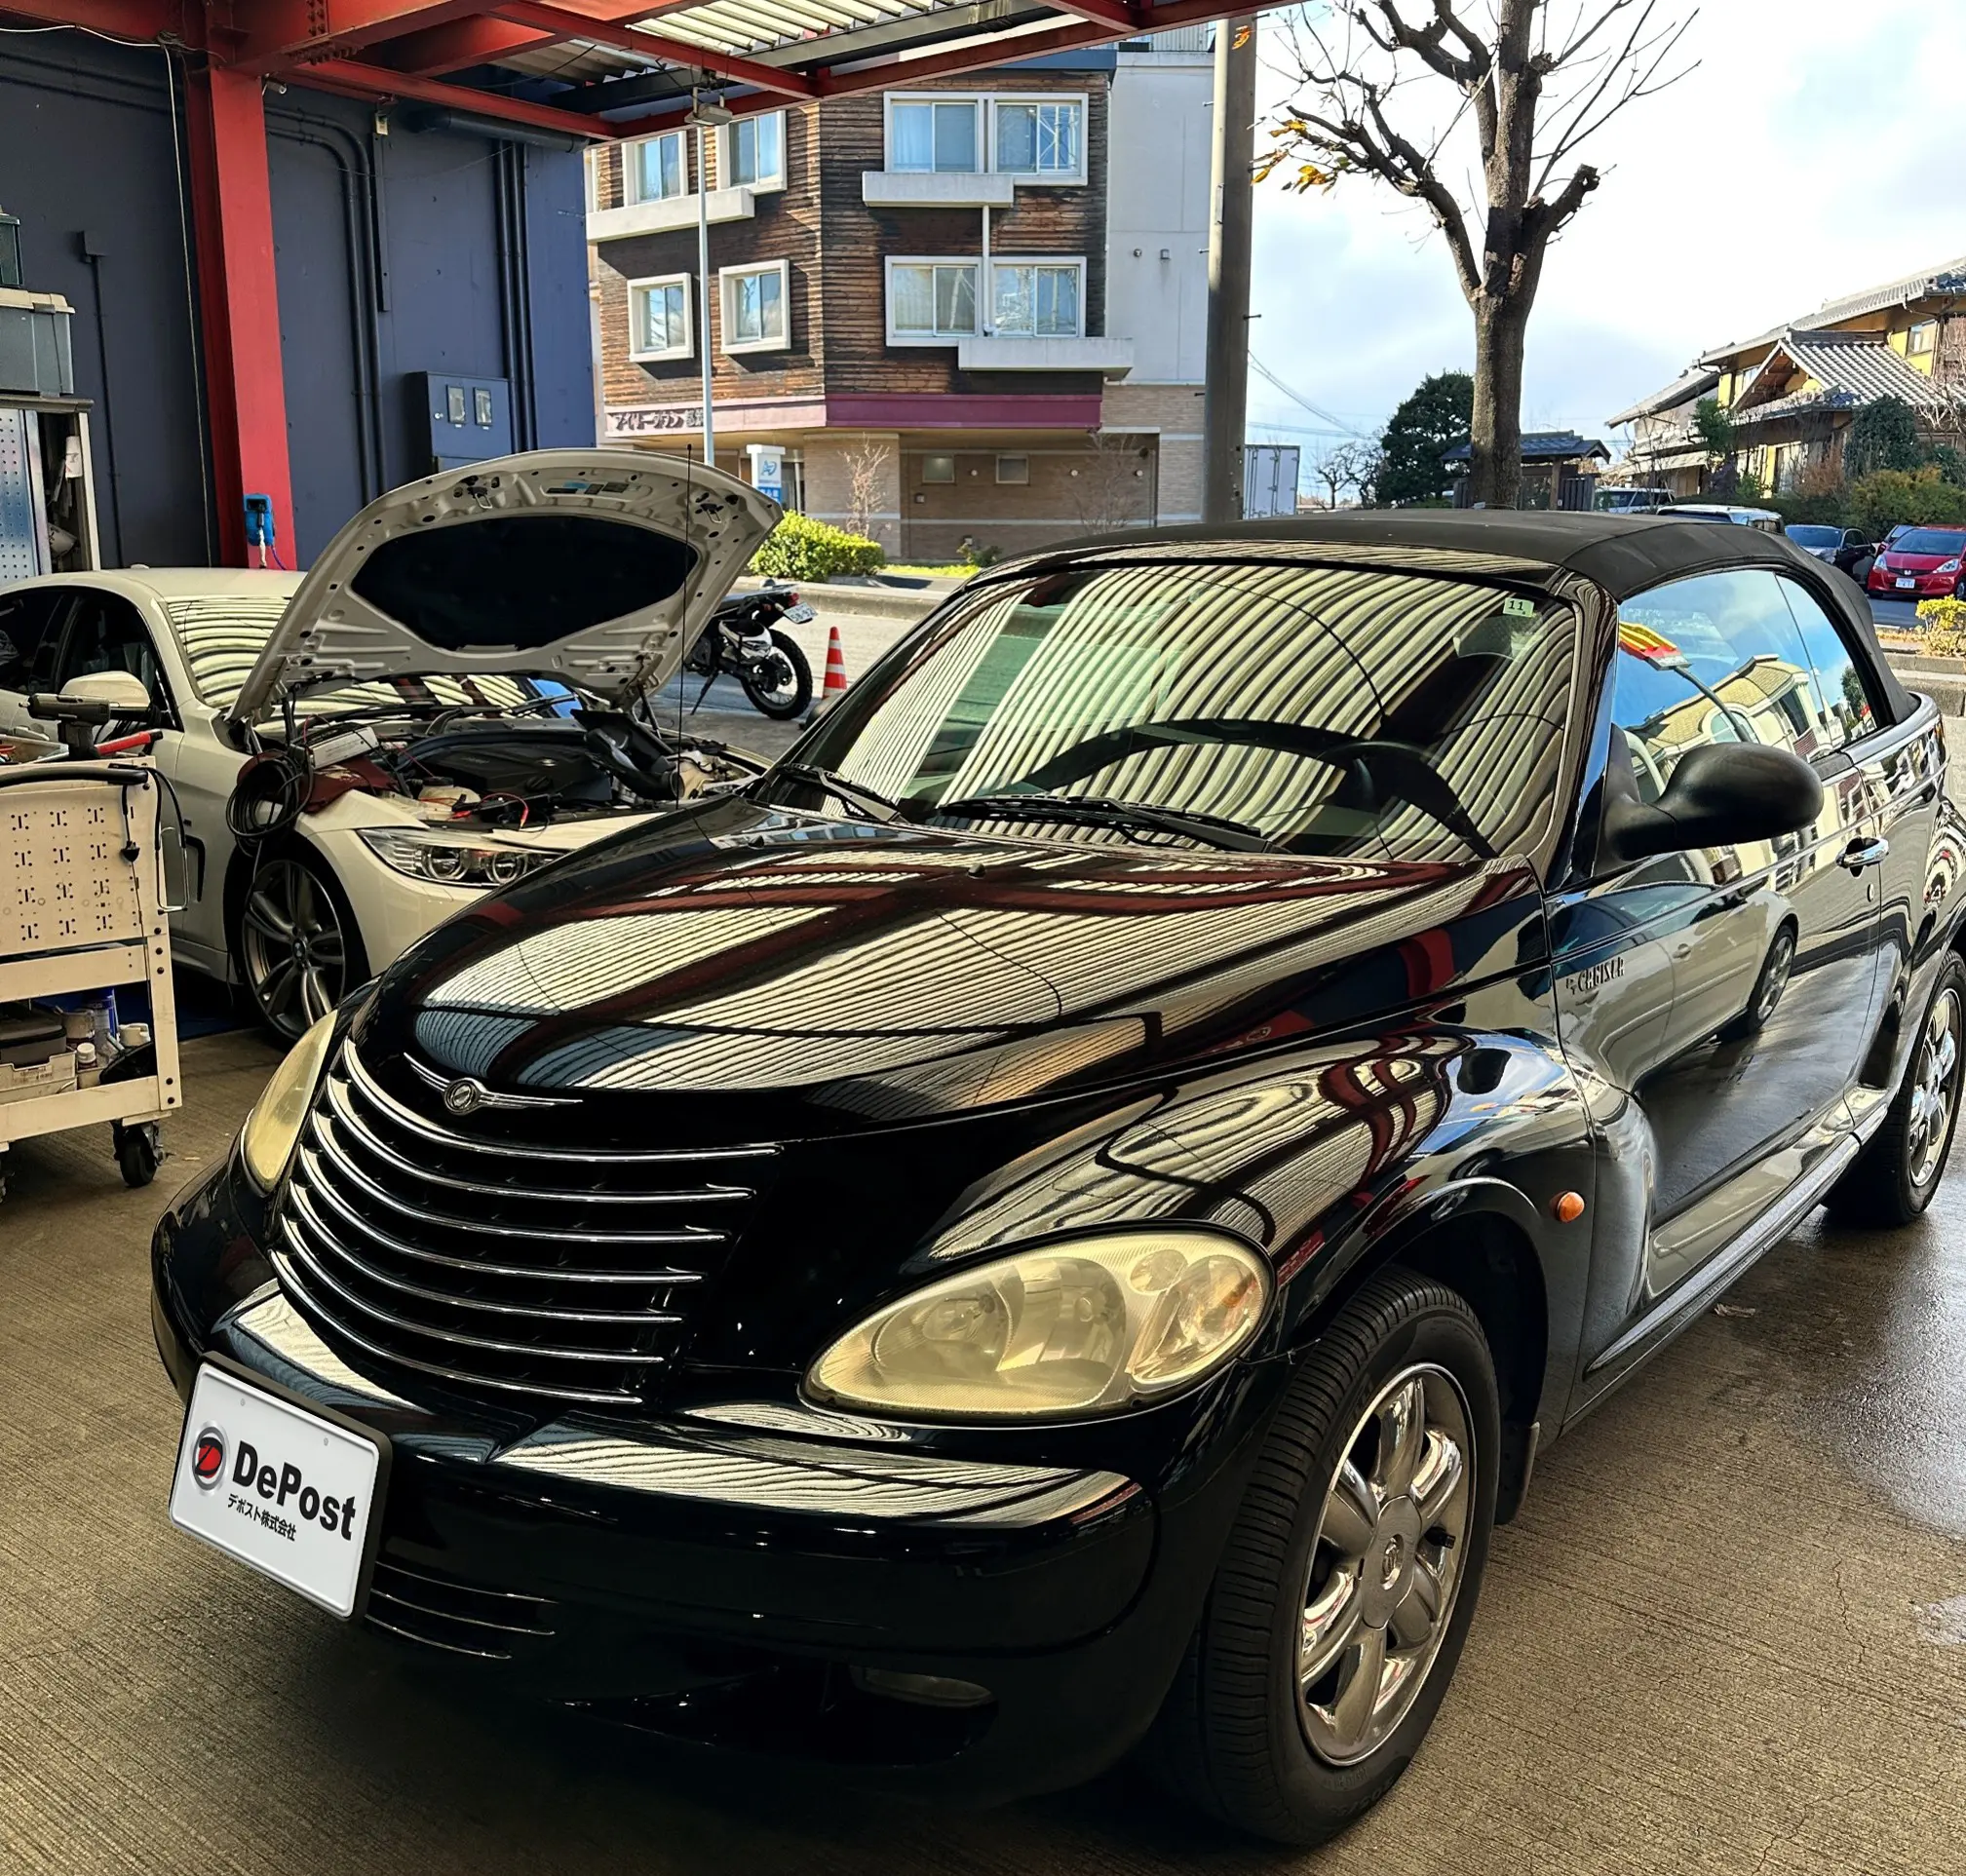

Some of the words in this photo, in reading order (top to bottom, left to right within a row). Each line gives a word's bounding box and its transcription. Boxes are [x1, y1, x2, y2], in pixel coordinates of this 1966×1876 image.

[227, 1493, 297, 1542] デポスト株式会社
[232, 1439, 357, 1542] DePost
